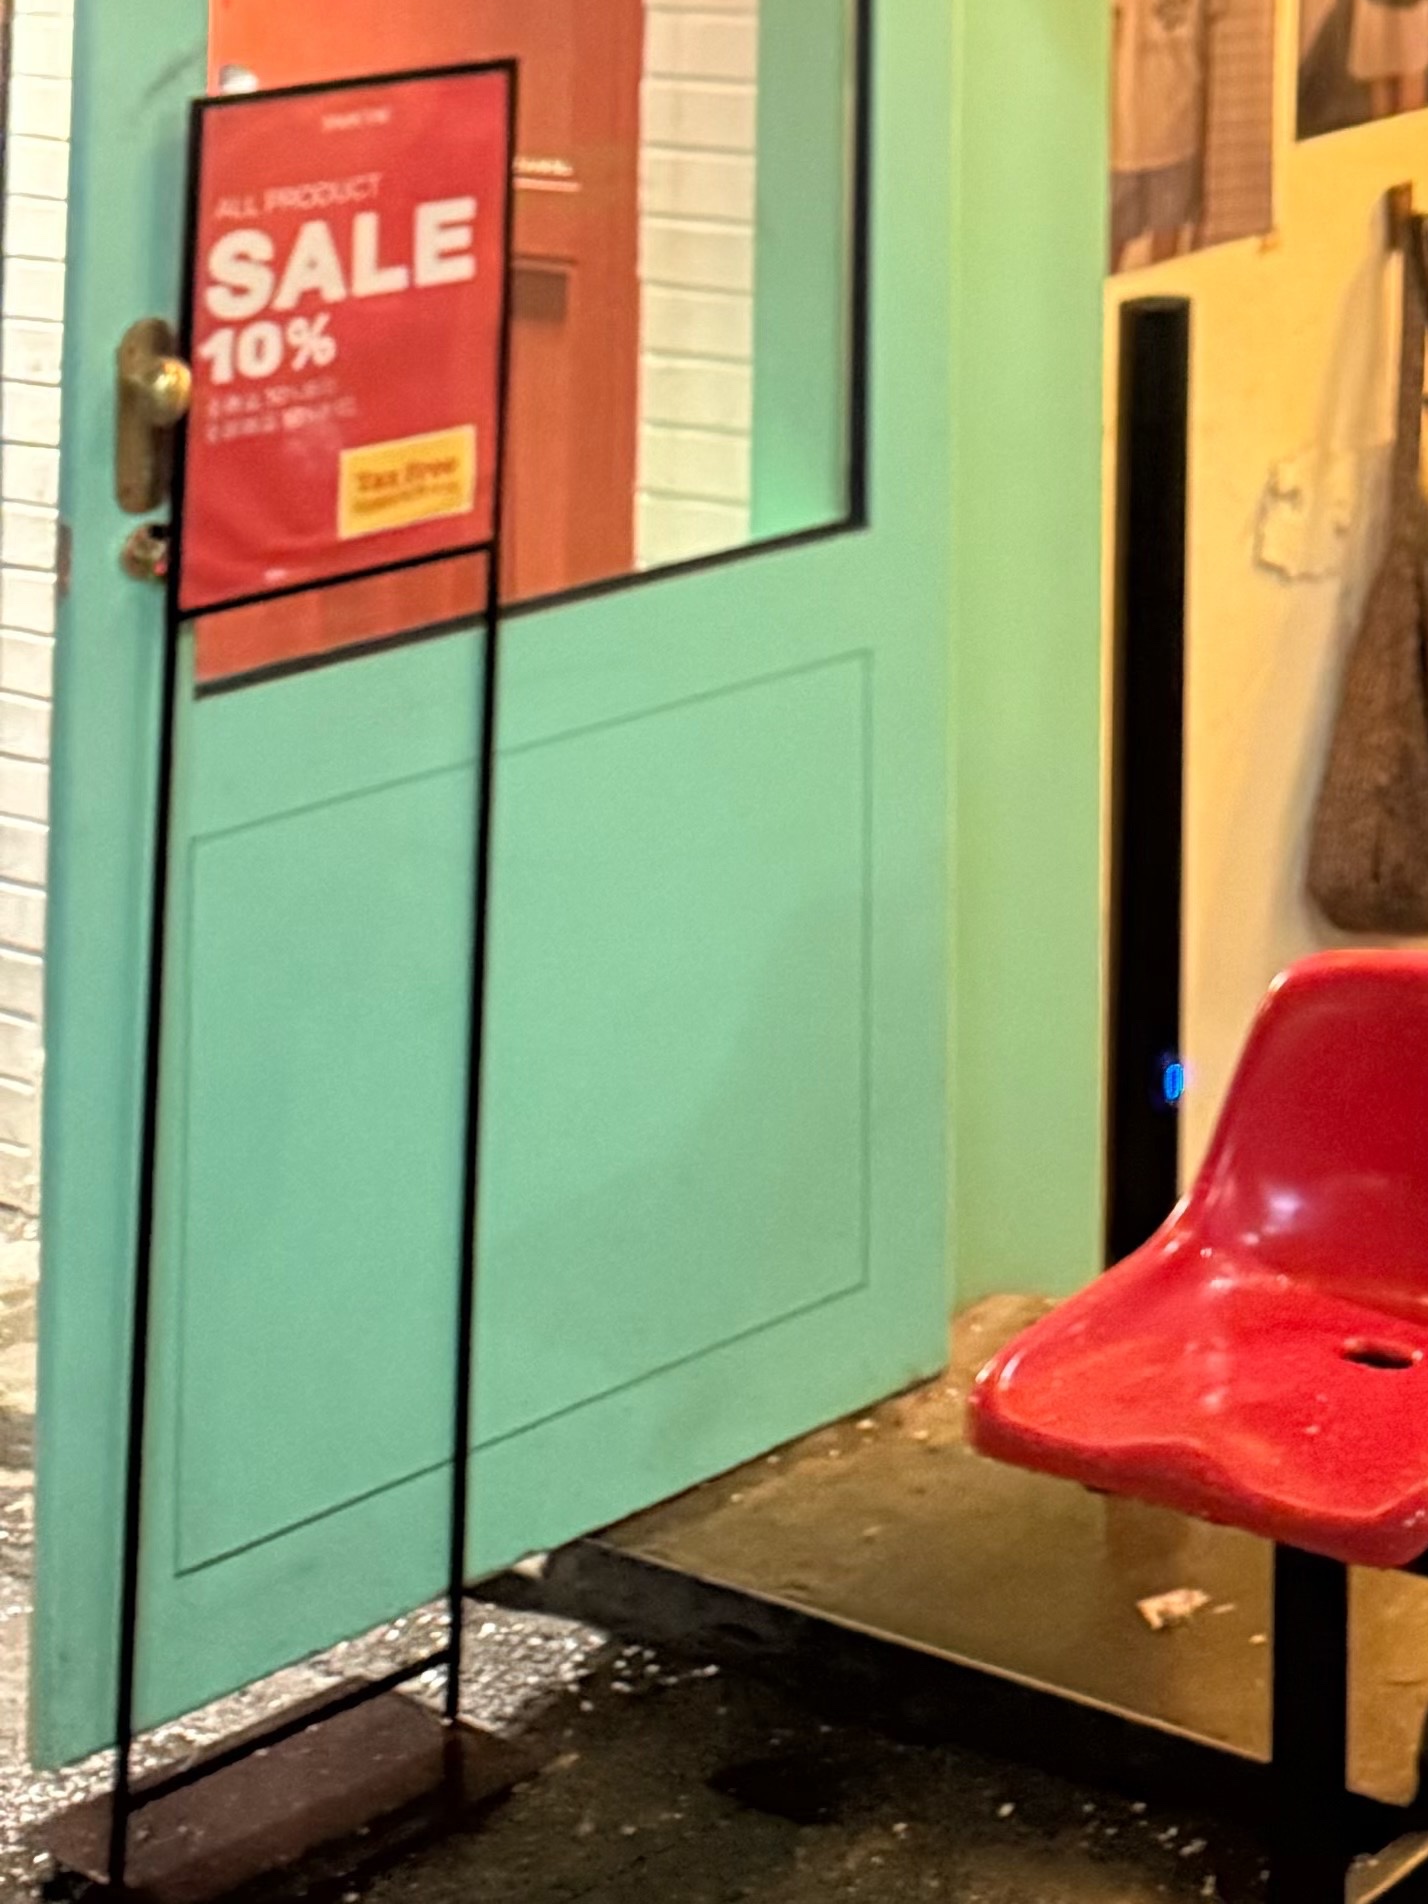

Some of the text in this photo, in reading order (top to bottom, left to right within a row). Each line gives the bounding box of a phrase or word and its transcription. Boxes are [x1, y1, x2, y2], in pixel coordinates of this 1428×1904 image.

[214, 171, 384, 220] ALL PRODUCT
[203, 195, 478, 320] SALE
[198, 311, 337, 386] 10%
